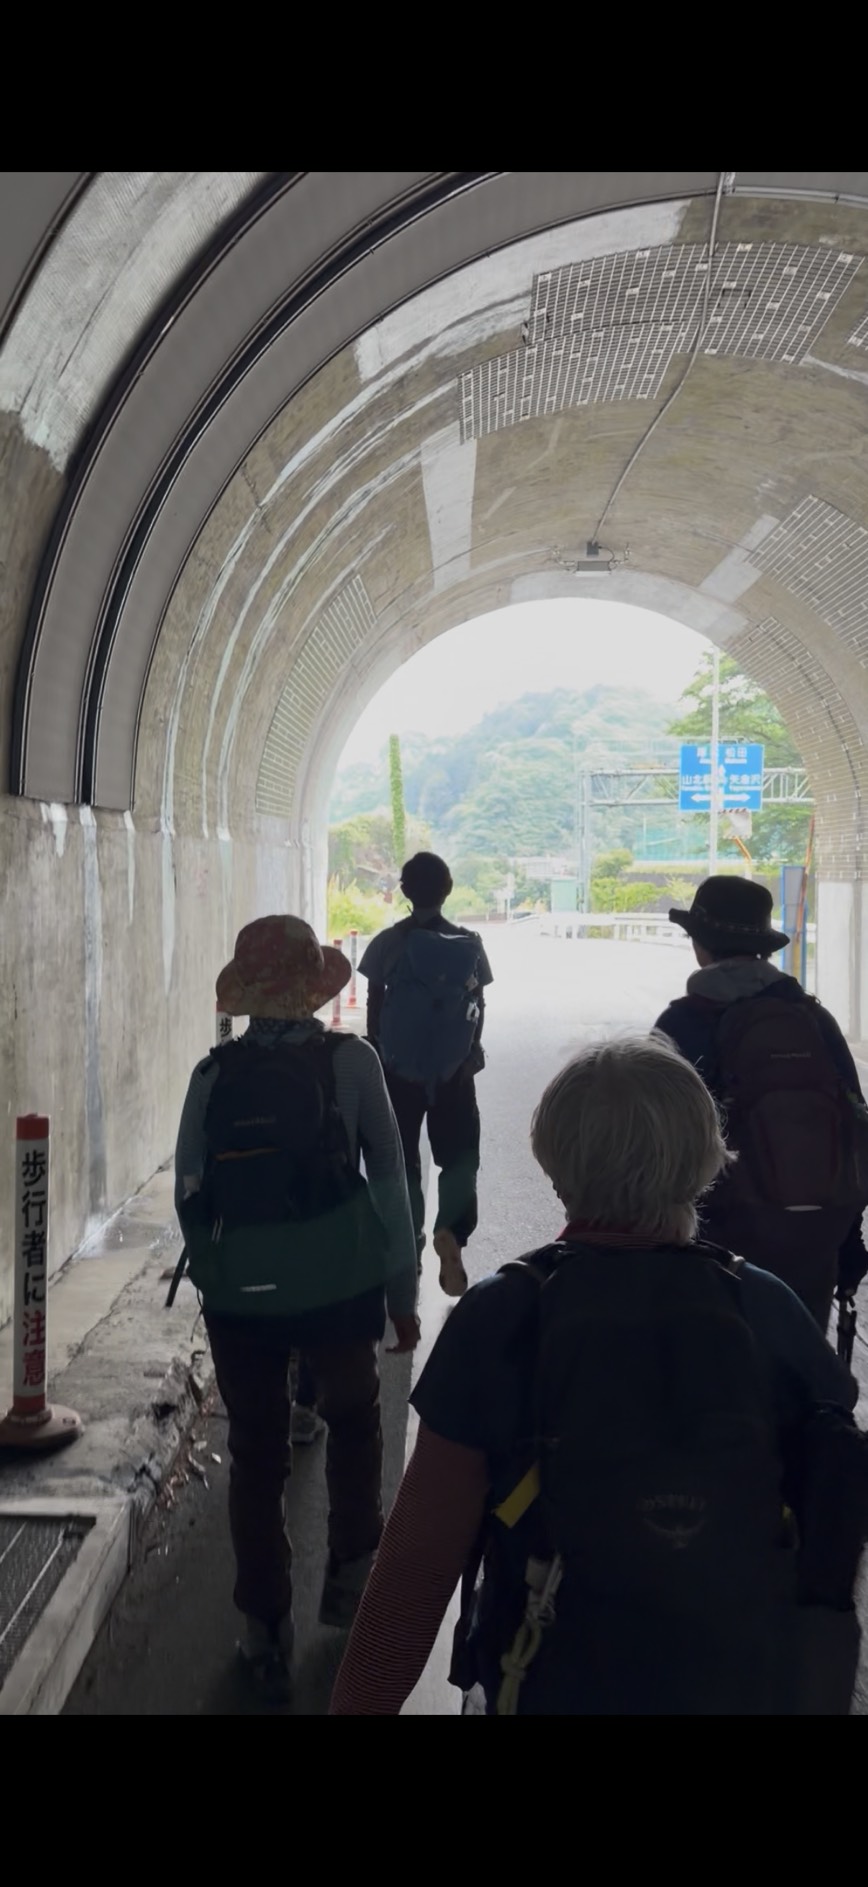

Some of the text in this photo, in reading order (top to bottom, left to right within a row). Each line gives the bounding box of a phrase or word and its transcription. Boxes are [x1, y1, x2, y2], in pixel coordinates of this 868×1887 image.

[21, 1150, 46, 1387] 歩行者に注意
